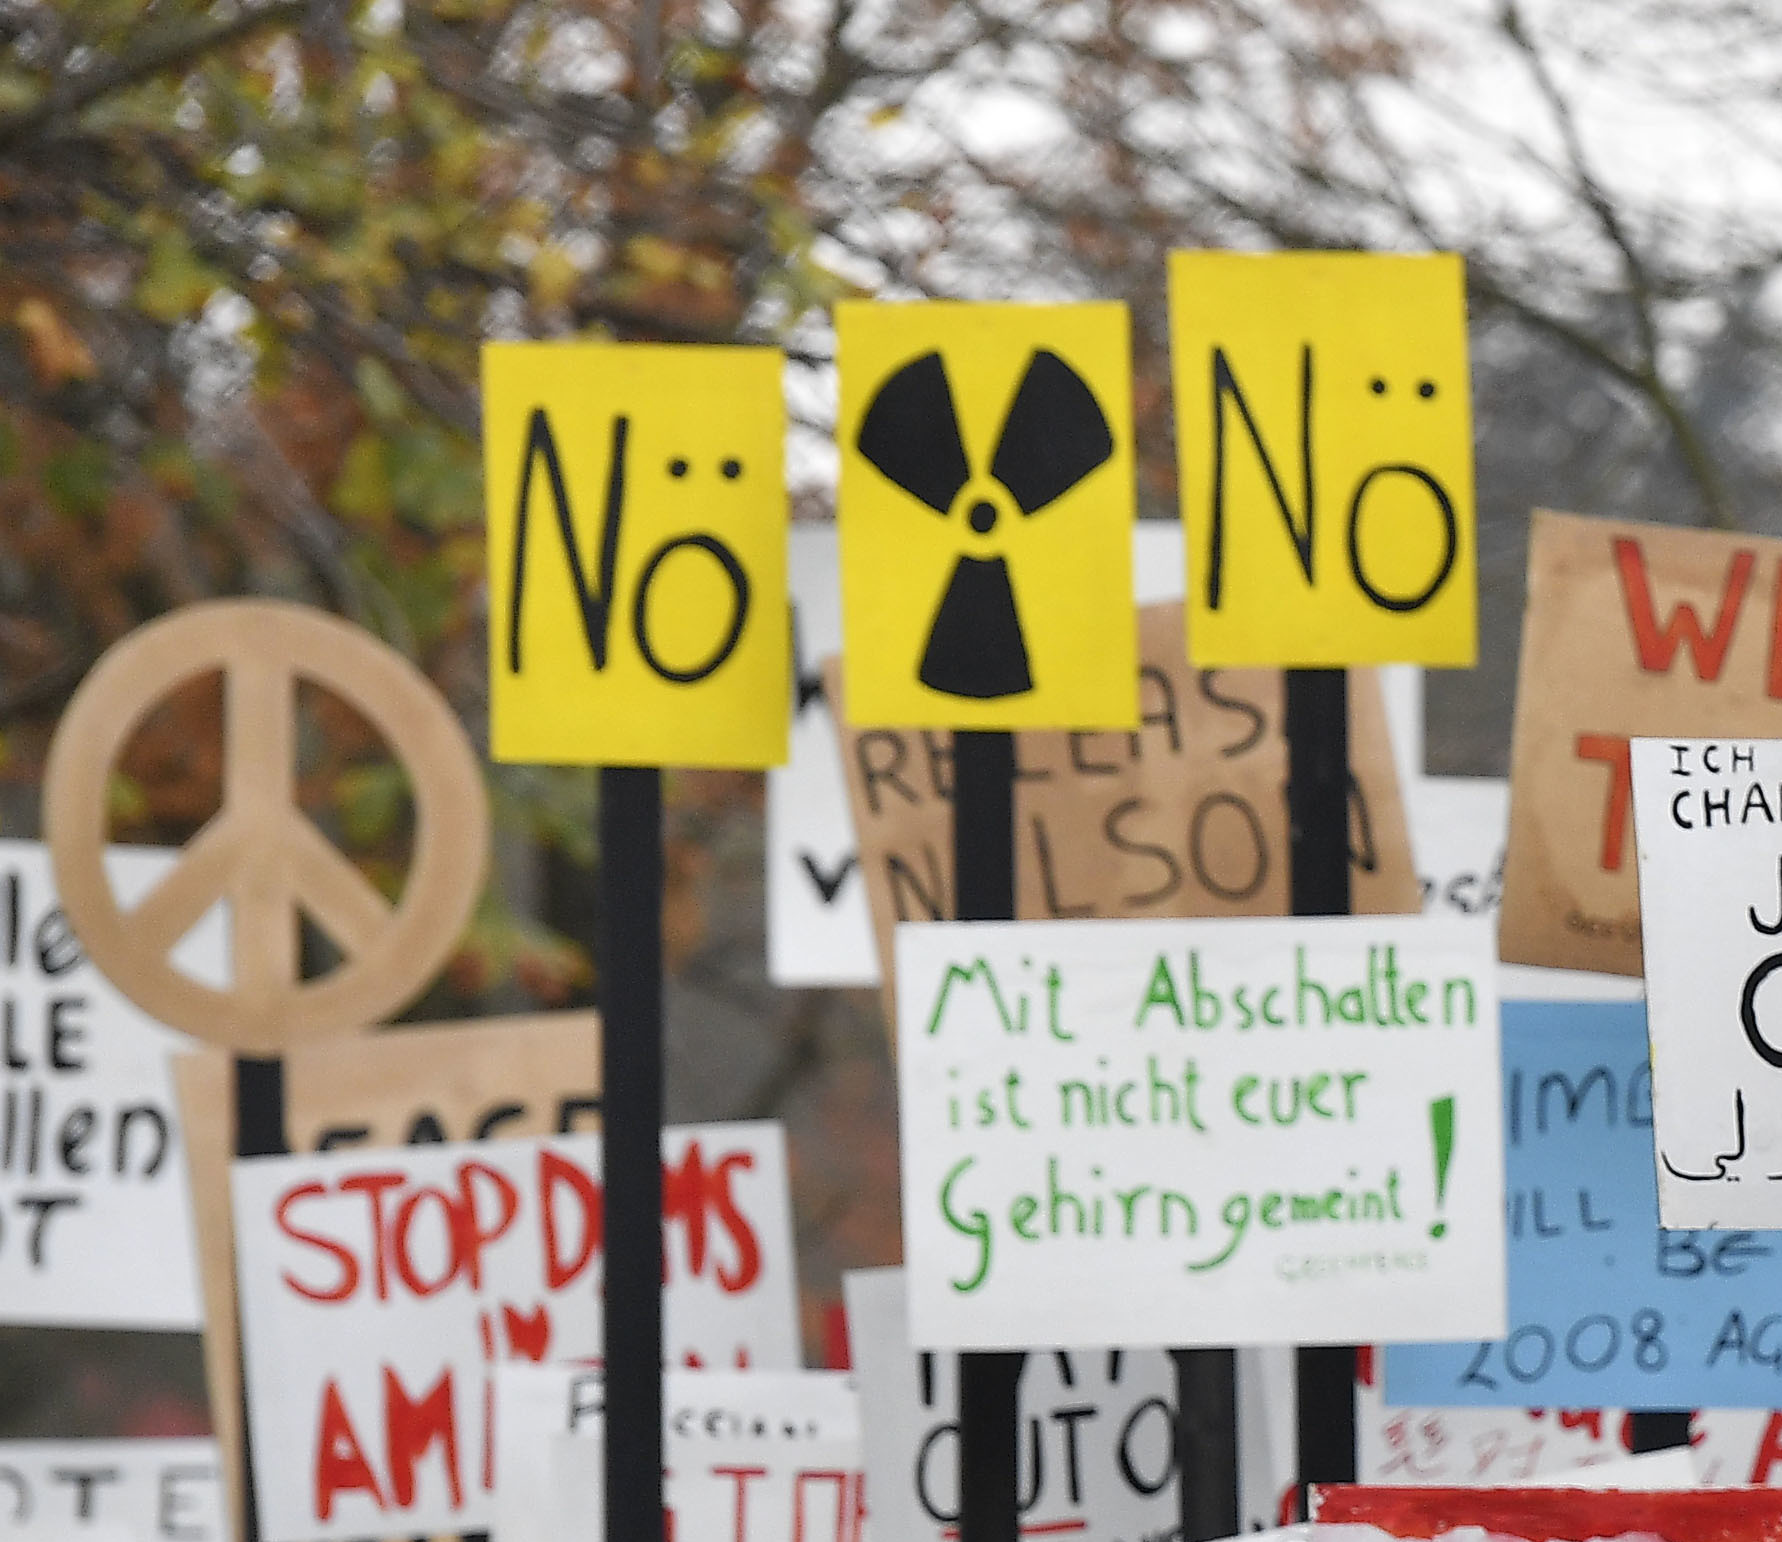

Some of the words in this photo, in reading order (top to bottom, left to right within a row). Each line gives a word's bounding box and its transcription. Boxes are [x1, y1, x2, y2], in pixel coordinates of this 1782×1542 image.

[1205, 343, 1458, 613] Nö
[508, 406, 752, 684] Nö
[1671, 745, 1755, 777] ICH
[926, 955, 1076, 1042] Mit
[1133, 942, 1477, 1031] Abschalten
[946, 1067, 1032, 1132] ist
[1059, 1053, 1209, 1135] nicht
[1230, 1068, 1368, 1128] euer
[275, 1160, 522, 1303] STOP
